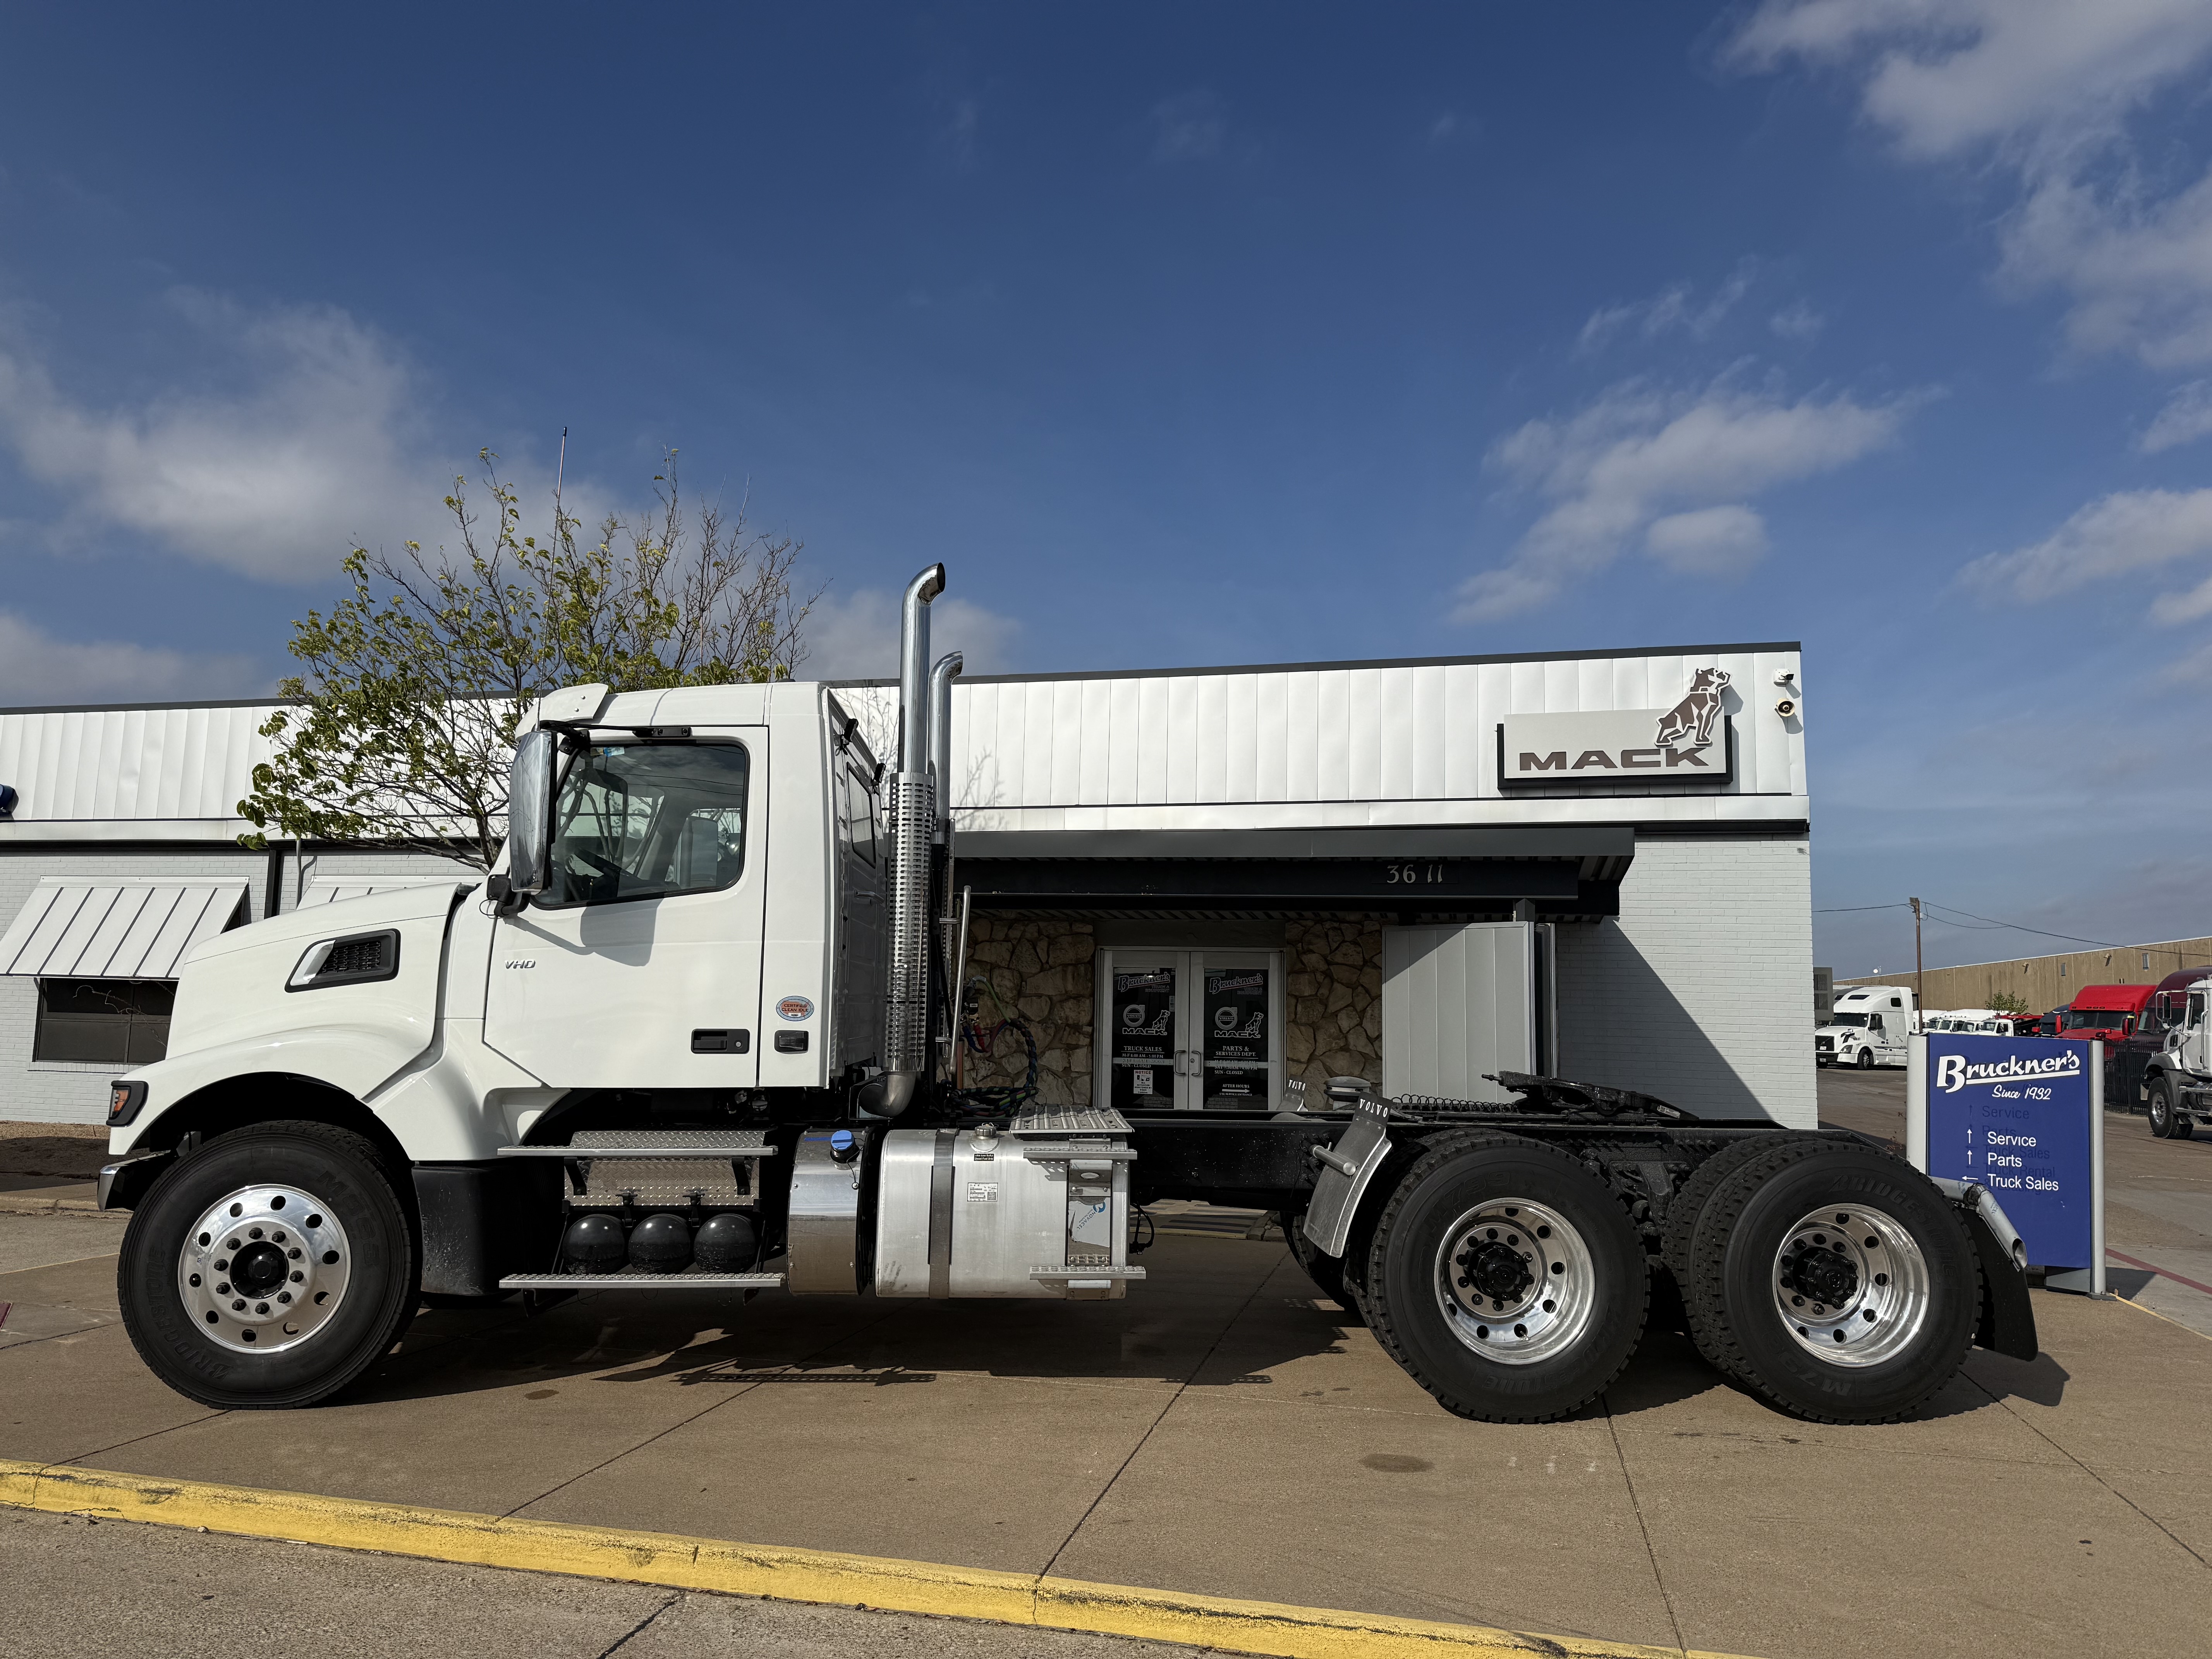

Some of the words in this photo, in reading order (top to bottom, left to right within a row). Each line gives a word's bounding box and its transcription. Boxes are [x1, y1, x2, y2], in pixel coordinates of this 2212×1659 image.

[1519, 747, 1709, 771] MACK
[504, 959, 536, 969] VHD
[1118, 972, 1170, 993] Bruckner's
[1209, 973, 1263, 994] Bruckner's
[1937, 1050, 2080, 1093] Bruckner's
[1288, 1079, 1306, 1091] VOLVO
[1992, 1084, 2021, 1099] Since
[2024, 1084, 2052, 1100] 1932
[1359, 1098, 1389, 1118] VOLVO
[1982, 1106, 2030, 1119] Service
[1987, 1131, 2037, 1147] Service
[1987, 1152, 2023, 1168] Parts
[1987, 1173, 2022, 1189] Truck
[2025, 1176, 2059, 1191] Sales
[1421, 1170, 1511, 1233] M799
[316, 1170, 380, 1266] M863
[1076, 1211, 1096, 1230] NOVACEL
[1828, 1175, 1956, 1276] BRIDGESTONE
[145, 1245, 234, 1382] BRIDGESTONE
